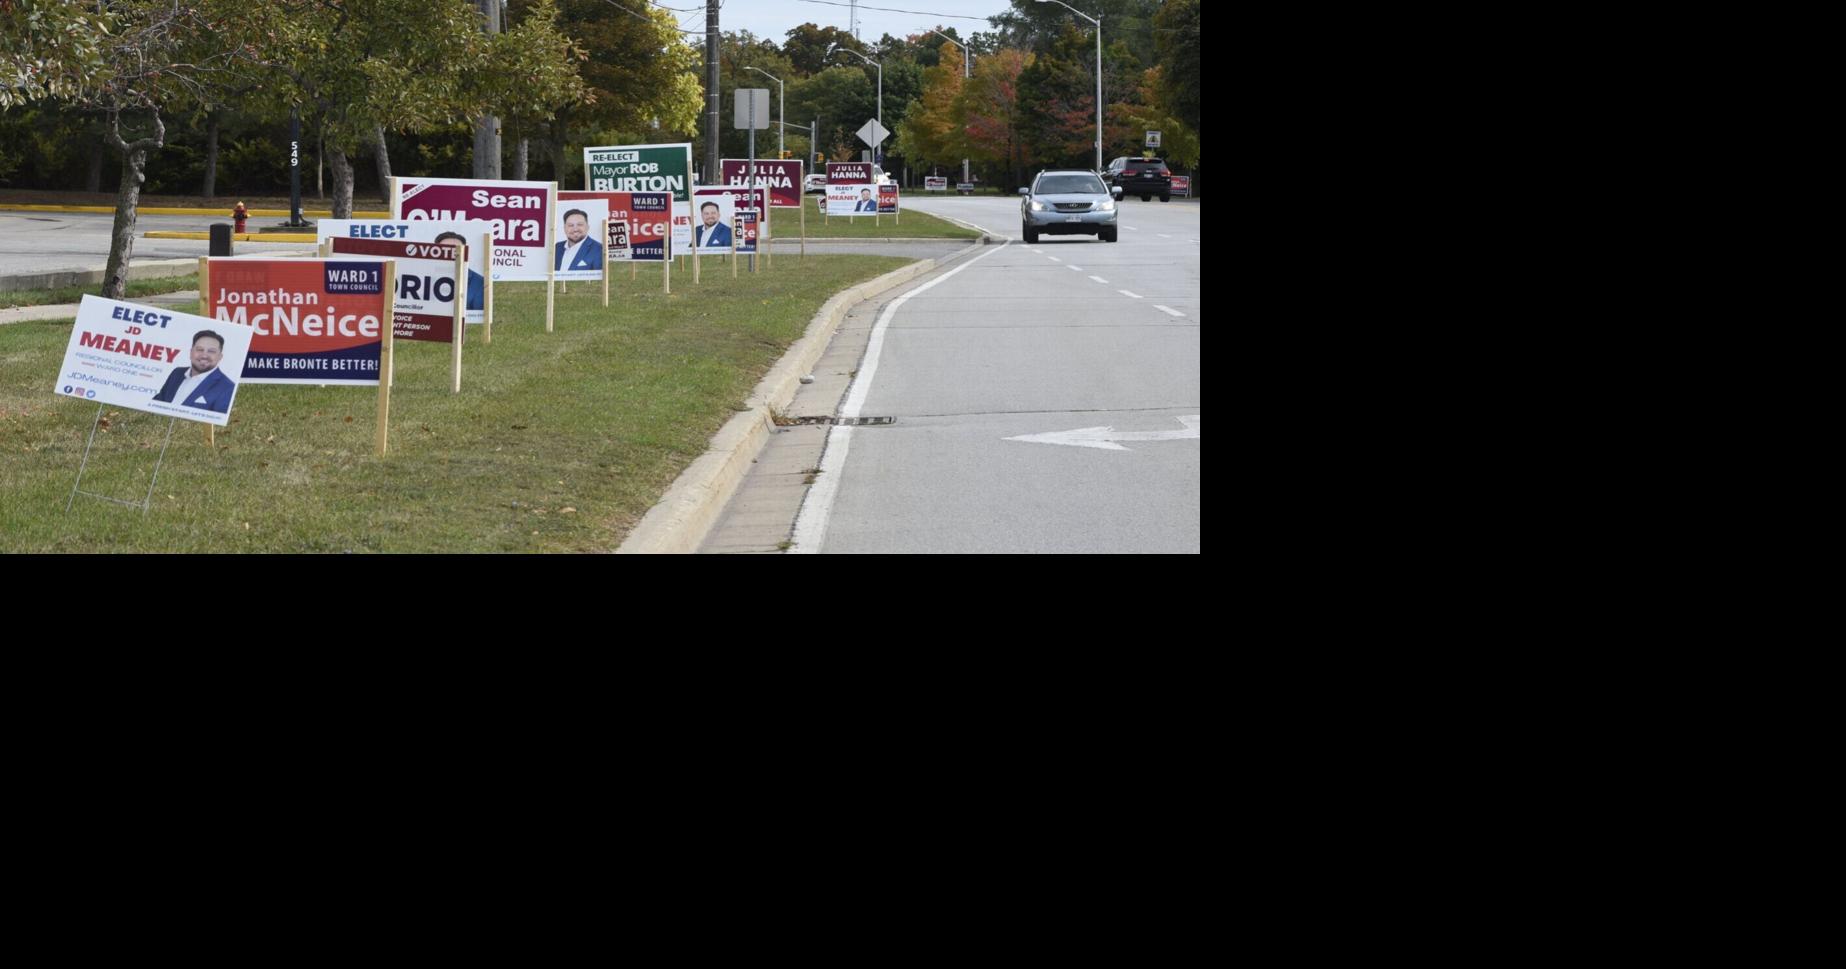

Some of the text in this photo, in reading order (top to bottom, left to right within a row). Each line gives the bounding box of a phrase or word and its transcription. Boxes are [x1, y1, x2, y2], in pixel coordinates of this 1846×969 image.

[593, 153, 633, 161] RE-ELECT
[593, 162, 659, 177] Mayor ROB
[594, 175, 684, 191] BURTON
[471, 189, 541, 209] Sean
[350, 225, 409, 238] ELECT
[418, 245, 458, 259] VOTE
[328, 270, 378, 283] WARD 1
[216, 287, 318, 305] Jonathan
[395, 274, 455, 302] RIO
[112, 306, 172, 328] ELECT
[215, 306, 379, 337] McNeice
[124, 326, 142, 336] JD
[79, 331, 181, 364] MEANEY
[248, 357, 379, 370] MAKE BRONTE BETTER!
[67, 371, 158, 395] JDMeaney.com
